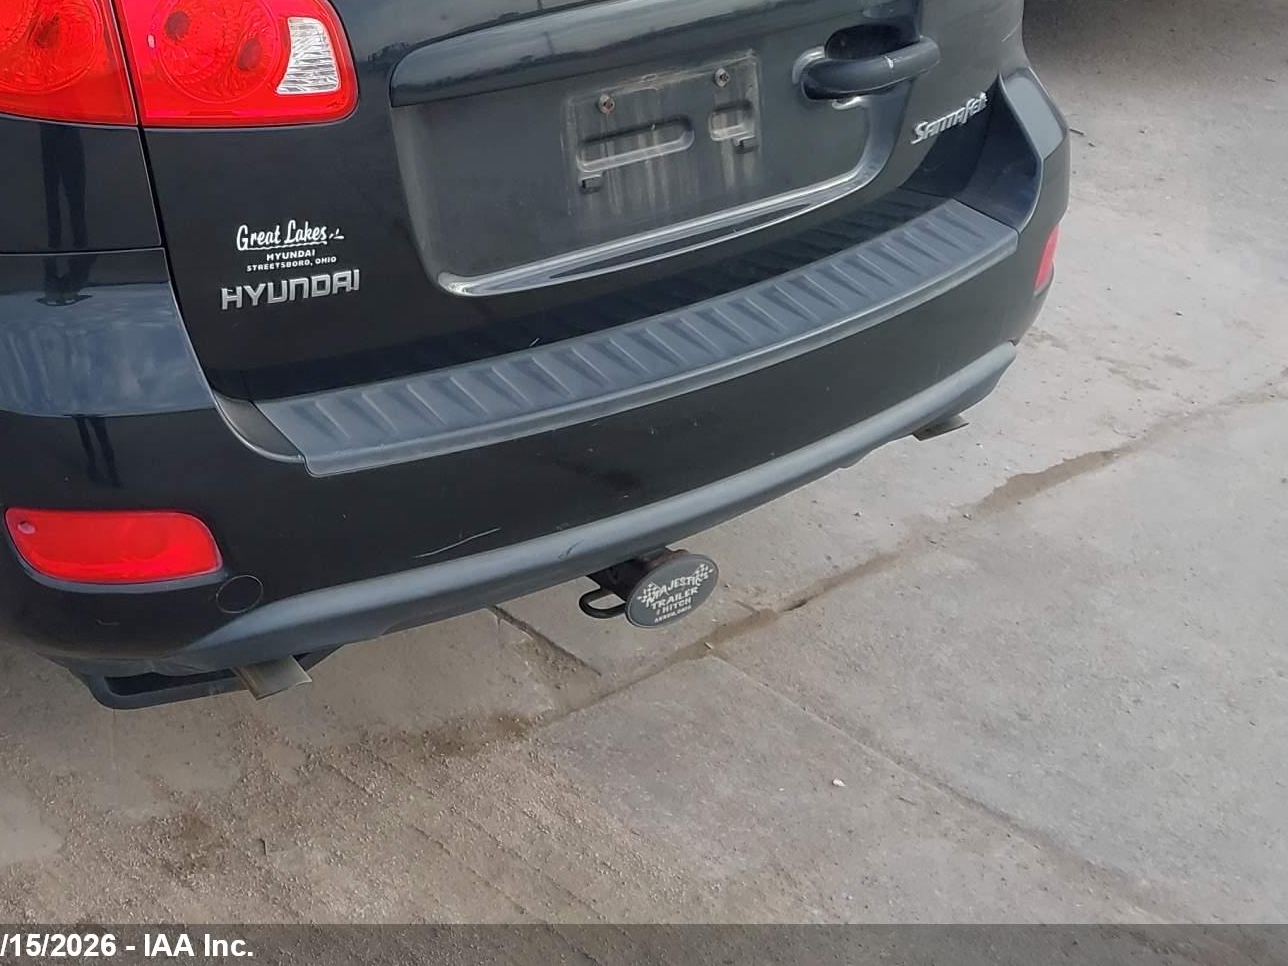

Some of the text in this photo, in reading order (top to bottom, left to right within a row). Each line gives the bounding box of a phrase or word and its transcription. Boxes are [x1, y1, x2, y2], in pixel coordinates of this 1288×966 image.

[236, 219, 328, 251] Great Lakes
[246, 256, 337, 272] STREETSBORO, OHIO
[266, 249, 316, 262] HYUNDAI
[220, 269, 361, 311] HYUNDAI
[646, 576, 703, 608] MAJESTIC
[651, 586, 699, 610] TRAILER
[662, 597, 692, 614] HITCH
